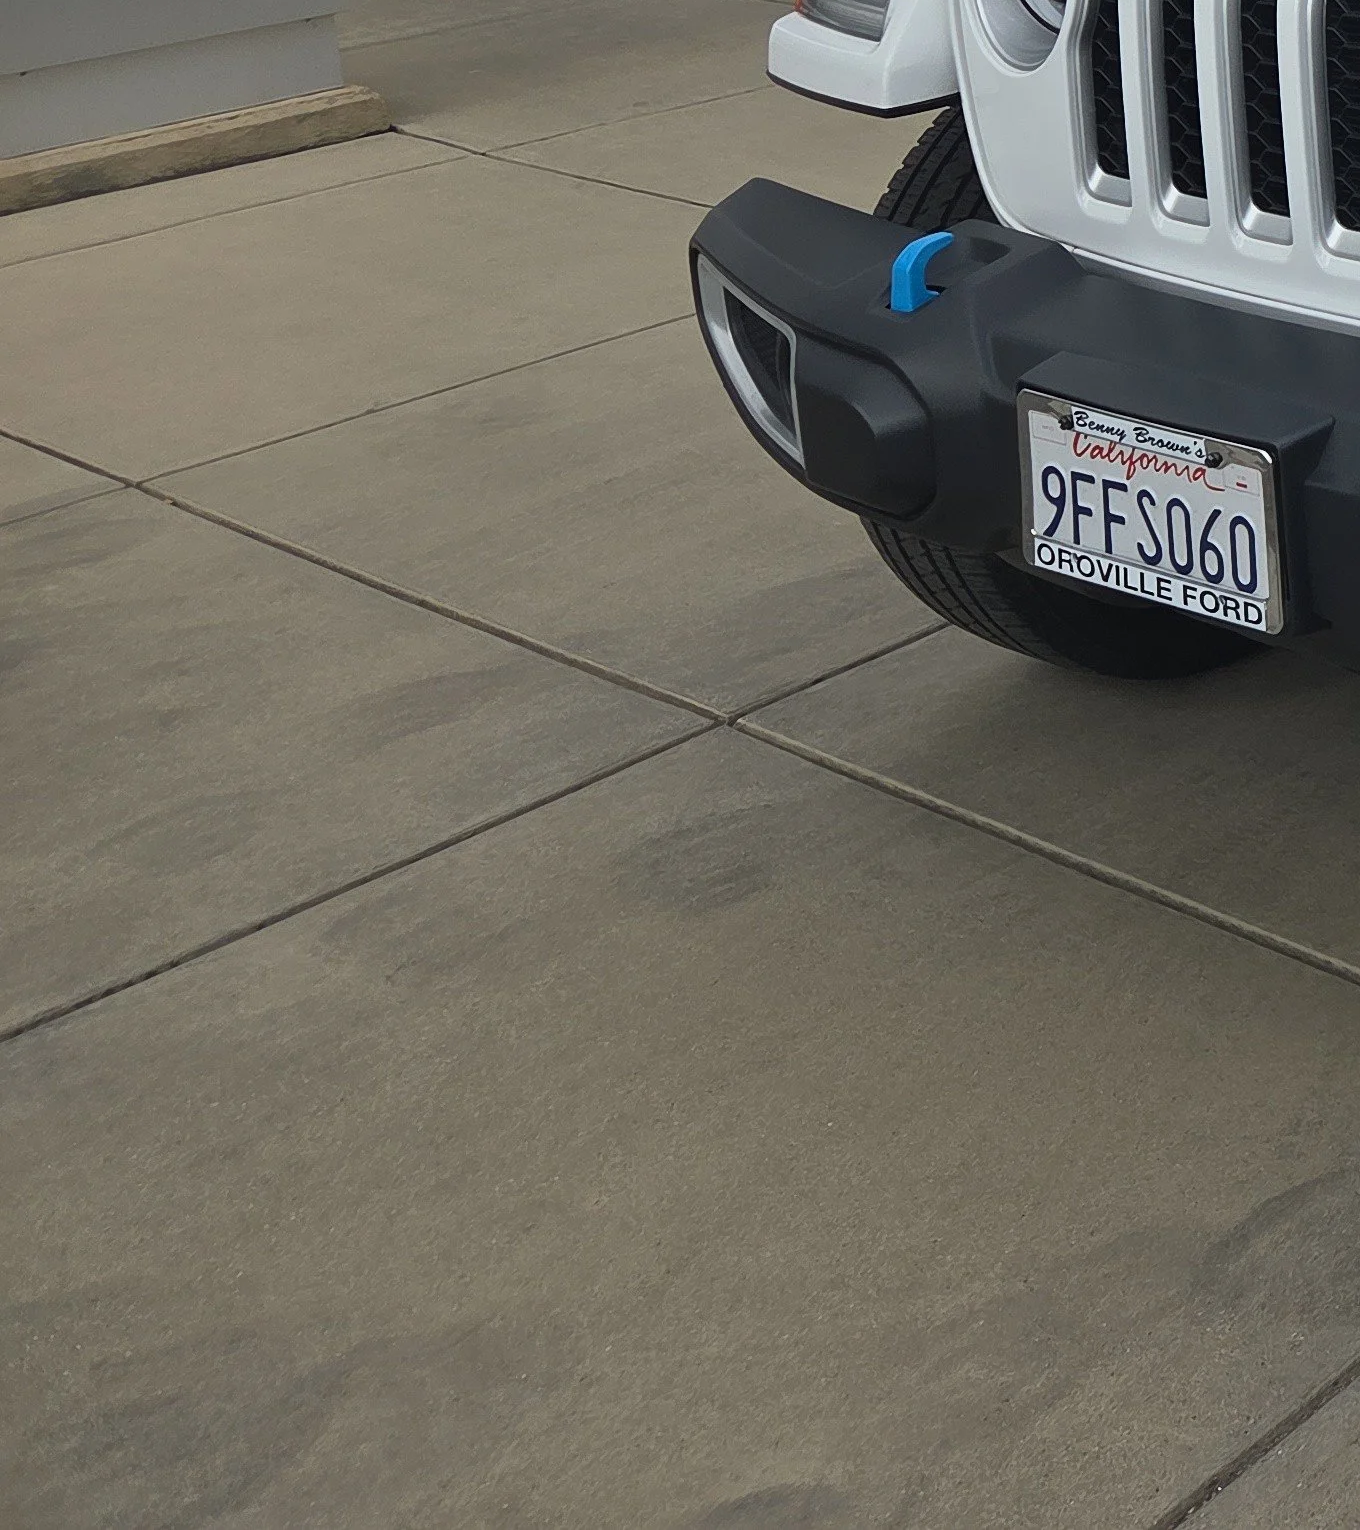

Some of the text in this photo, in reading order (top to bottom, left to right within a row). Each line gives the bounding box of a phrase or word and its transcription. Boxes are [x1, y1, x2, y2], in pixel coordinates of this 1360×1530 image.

[1072, 431, 1226, 491] California
[1073, 410, 1207, 459] Benny Brown's
[1041, 465, 1258, 595] 9FFS060
[1036, 543, 1263, 626] OROVILLE FORD
